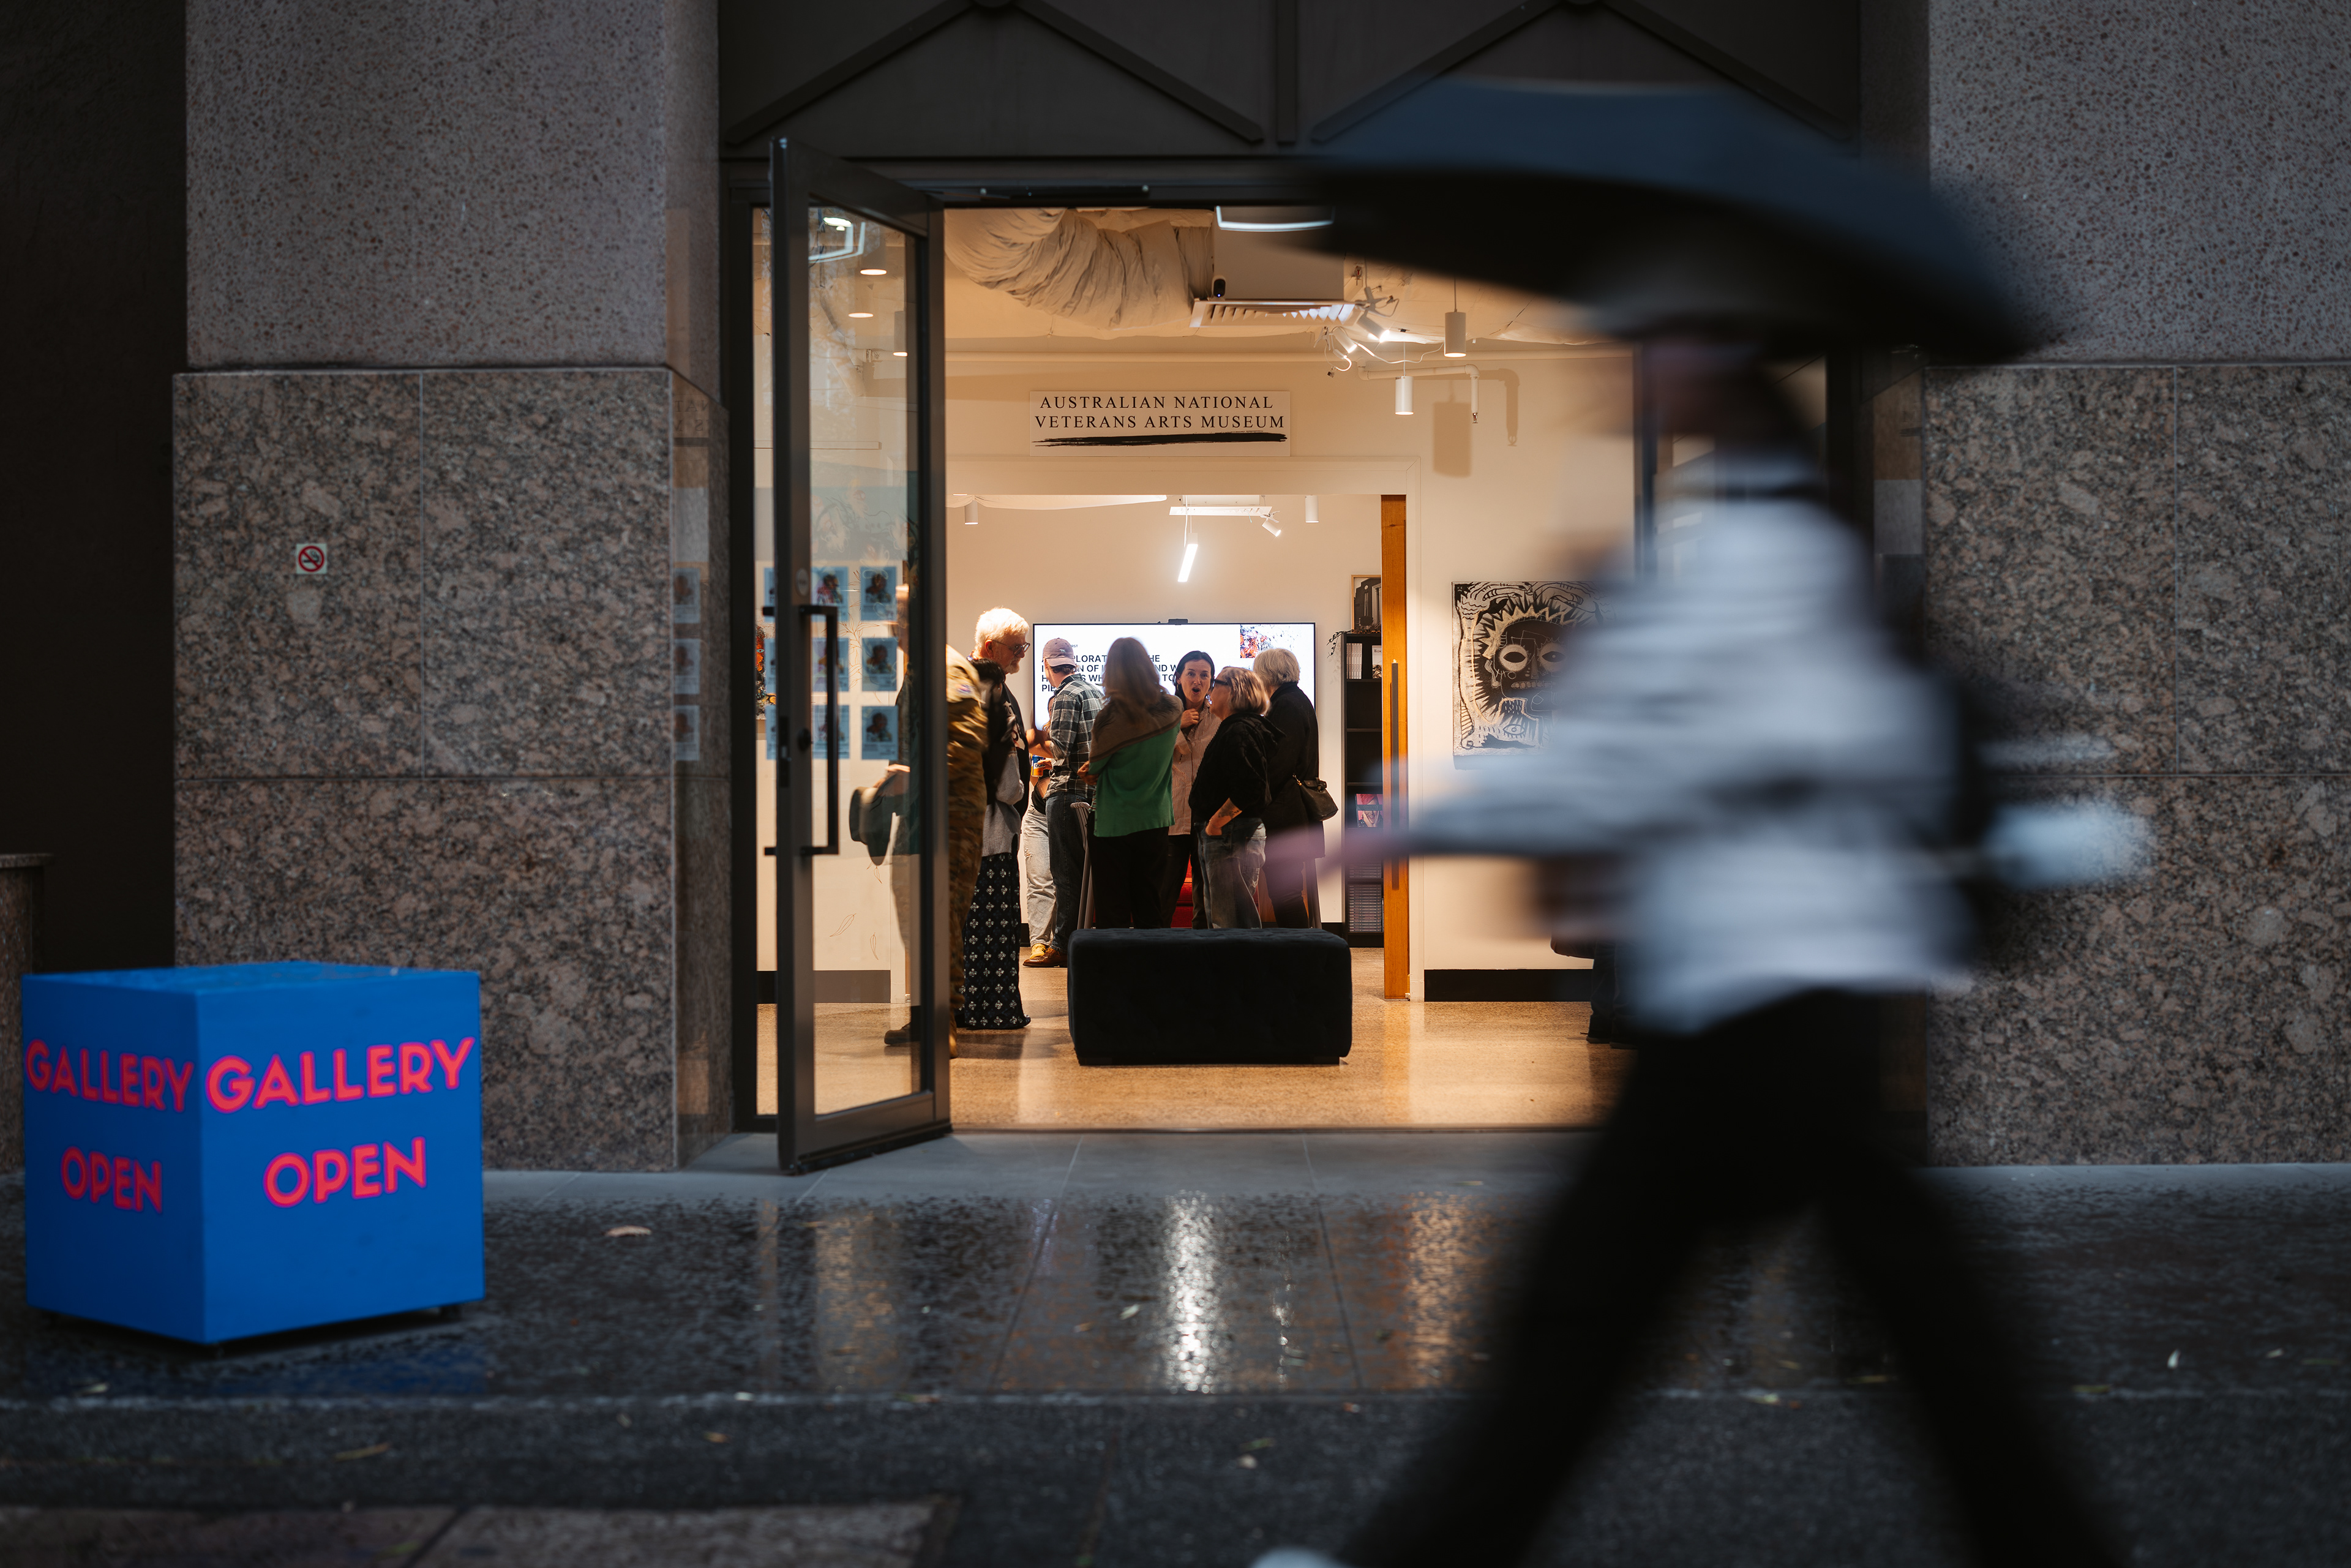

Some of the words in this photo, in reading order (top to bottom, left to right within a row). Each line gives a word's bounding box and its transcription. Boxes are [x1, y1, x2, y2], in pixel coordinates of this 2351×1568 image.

[1035, 416, 1136, 429] VETERANS
[1144, 416, 1192, 429] ARTS
[1201, 416, 1284, 429] MUSEUM
[1040, 396, 1166, 409] AUSTRALIAN
[1174, 396, 1273, 409] NATIONAL
[26, 1039, 194, 1112] GALLERY
[206, 1037, 475, 1113] GALLERY
[61, 1146, 162, 1214] OPEN
[263, 1136, 427, 1208] OPEN
